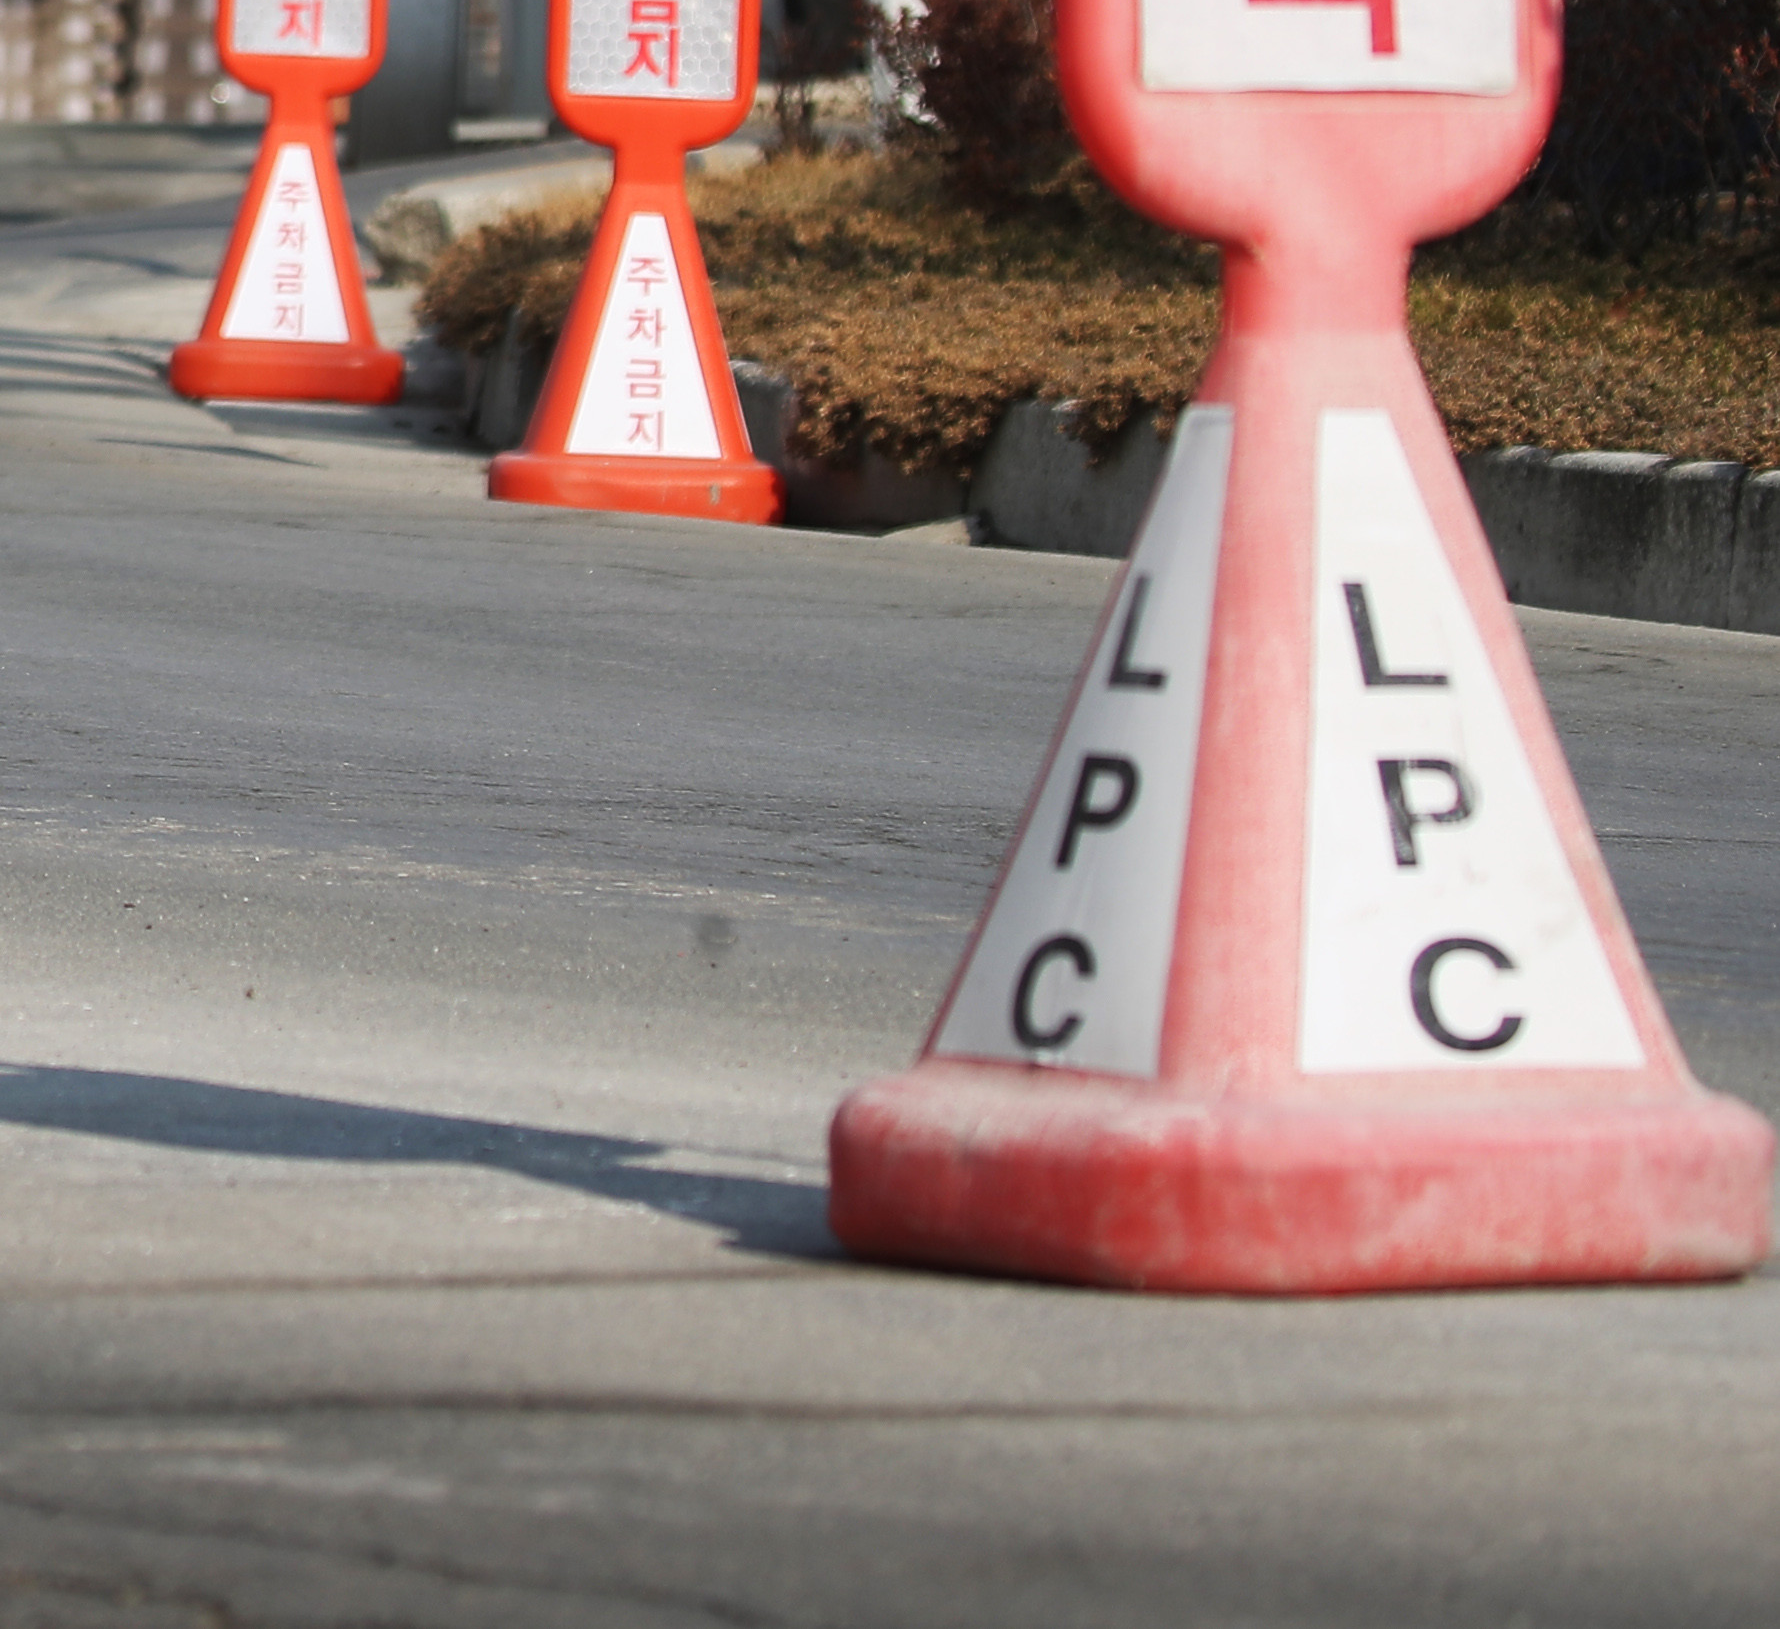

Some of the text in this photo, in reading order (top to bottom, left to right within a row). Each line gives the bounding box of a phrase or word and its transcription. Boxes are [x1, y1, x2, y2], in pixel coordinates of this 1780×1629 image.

[272, 181, 311, 338] 주차금지
[624, 256, 668, 452] 주차금지
[1012, 574, 1168, 1055] LPC
[1342, 582, 1525, 1054] LPC
